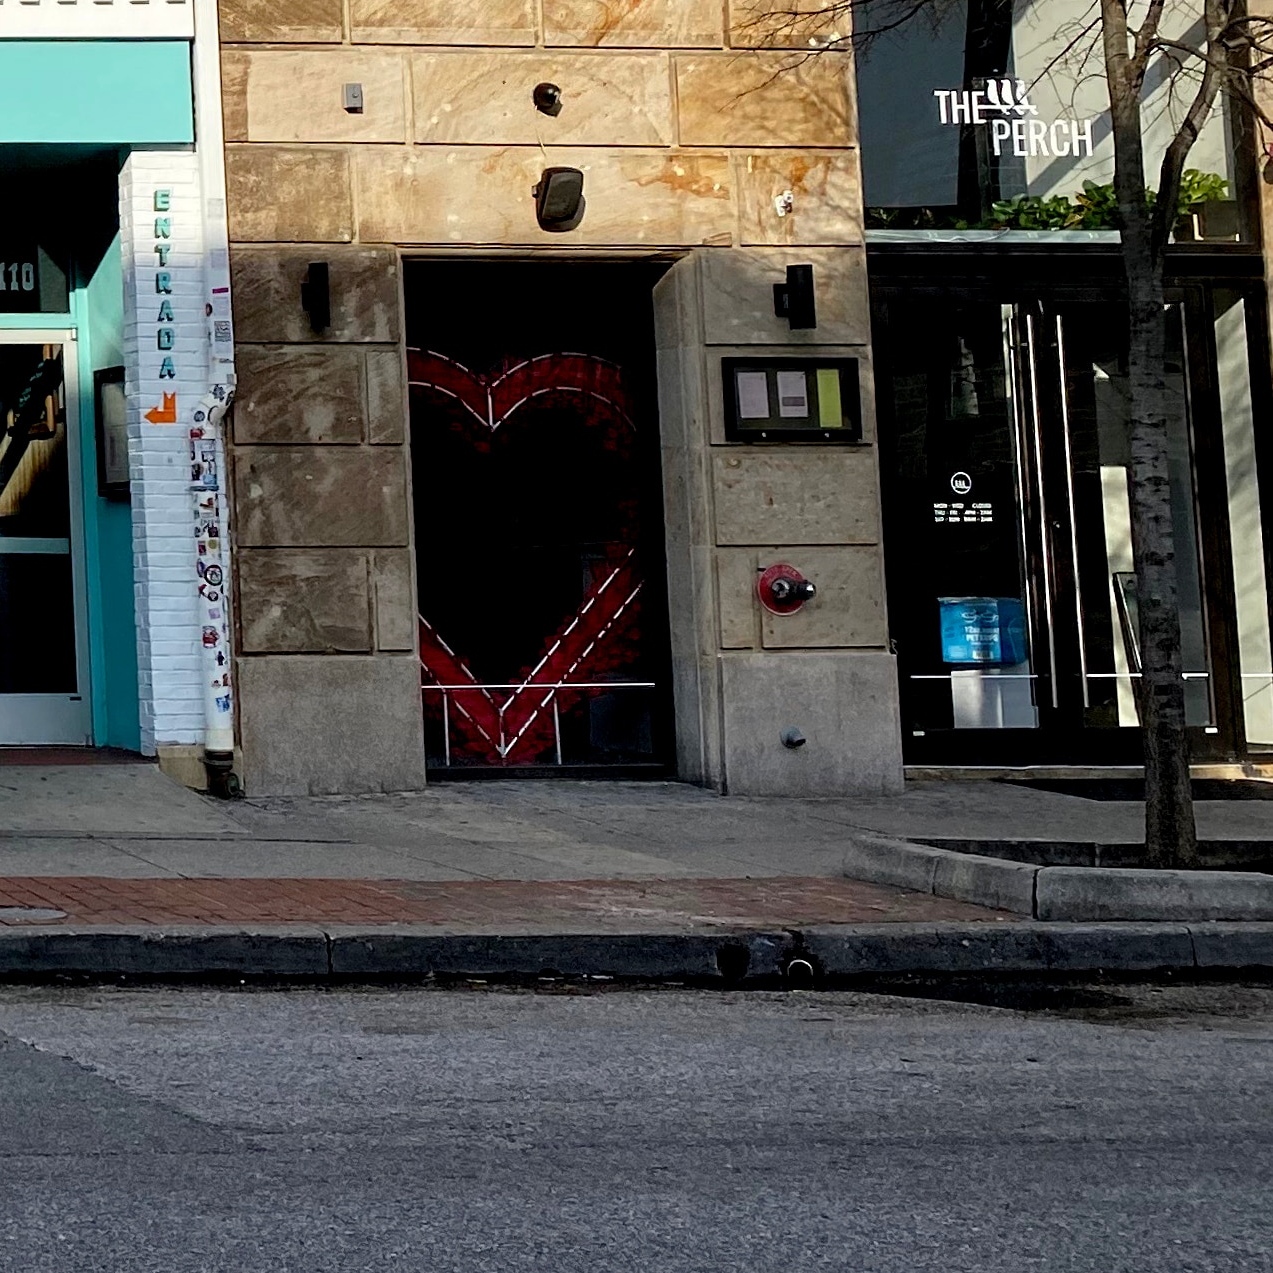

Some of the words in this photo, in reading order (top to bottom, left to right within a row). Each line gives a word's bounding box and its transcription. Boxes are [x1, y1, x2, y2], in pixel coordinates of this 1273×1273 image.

[934, 90, 987, 124] THE
[992, 119, 1093, 157] PERCH
[154, 189, 176, 379] ENTRADA
